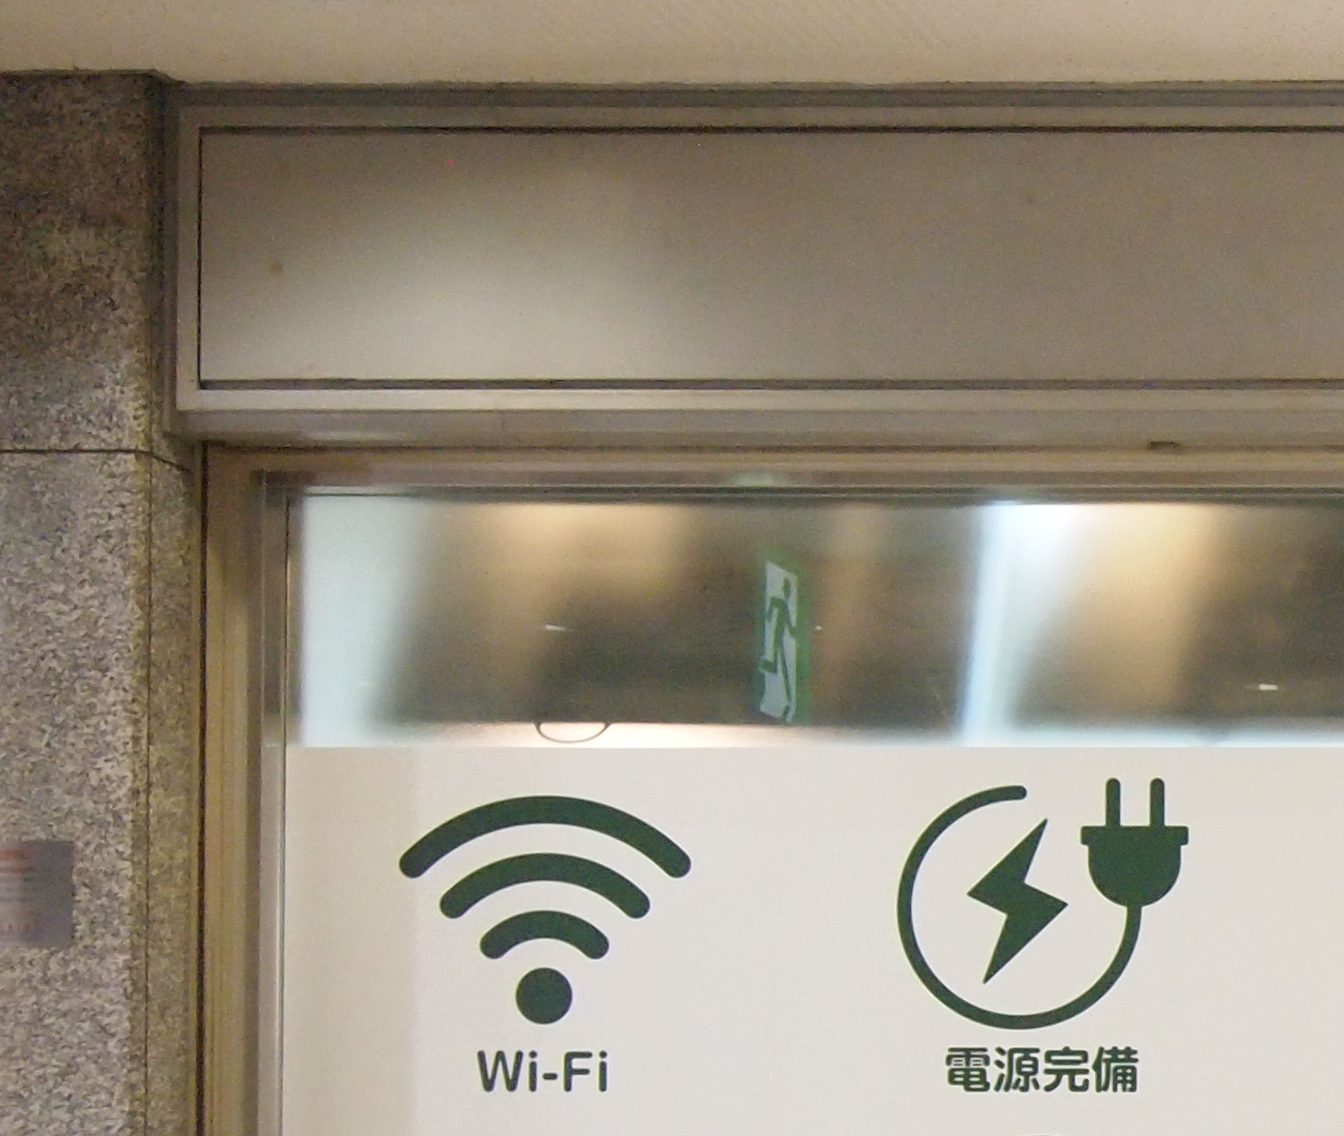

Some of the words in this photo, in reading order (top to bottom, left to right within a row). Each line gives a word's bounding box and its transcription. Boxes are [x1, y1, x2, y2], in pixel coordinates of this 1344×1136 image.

[476, 1050, 608, 1093] Wi-Fi
[945, 1045, 1139, 1093] 電源完備
